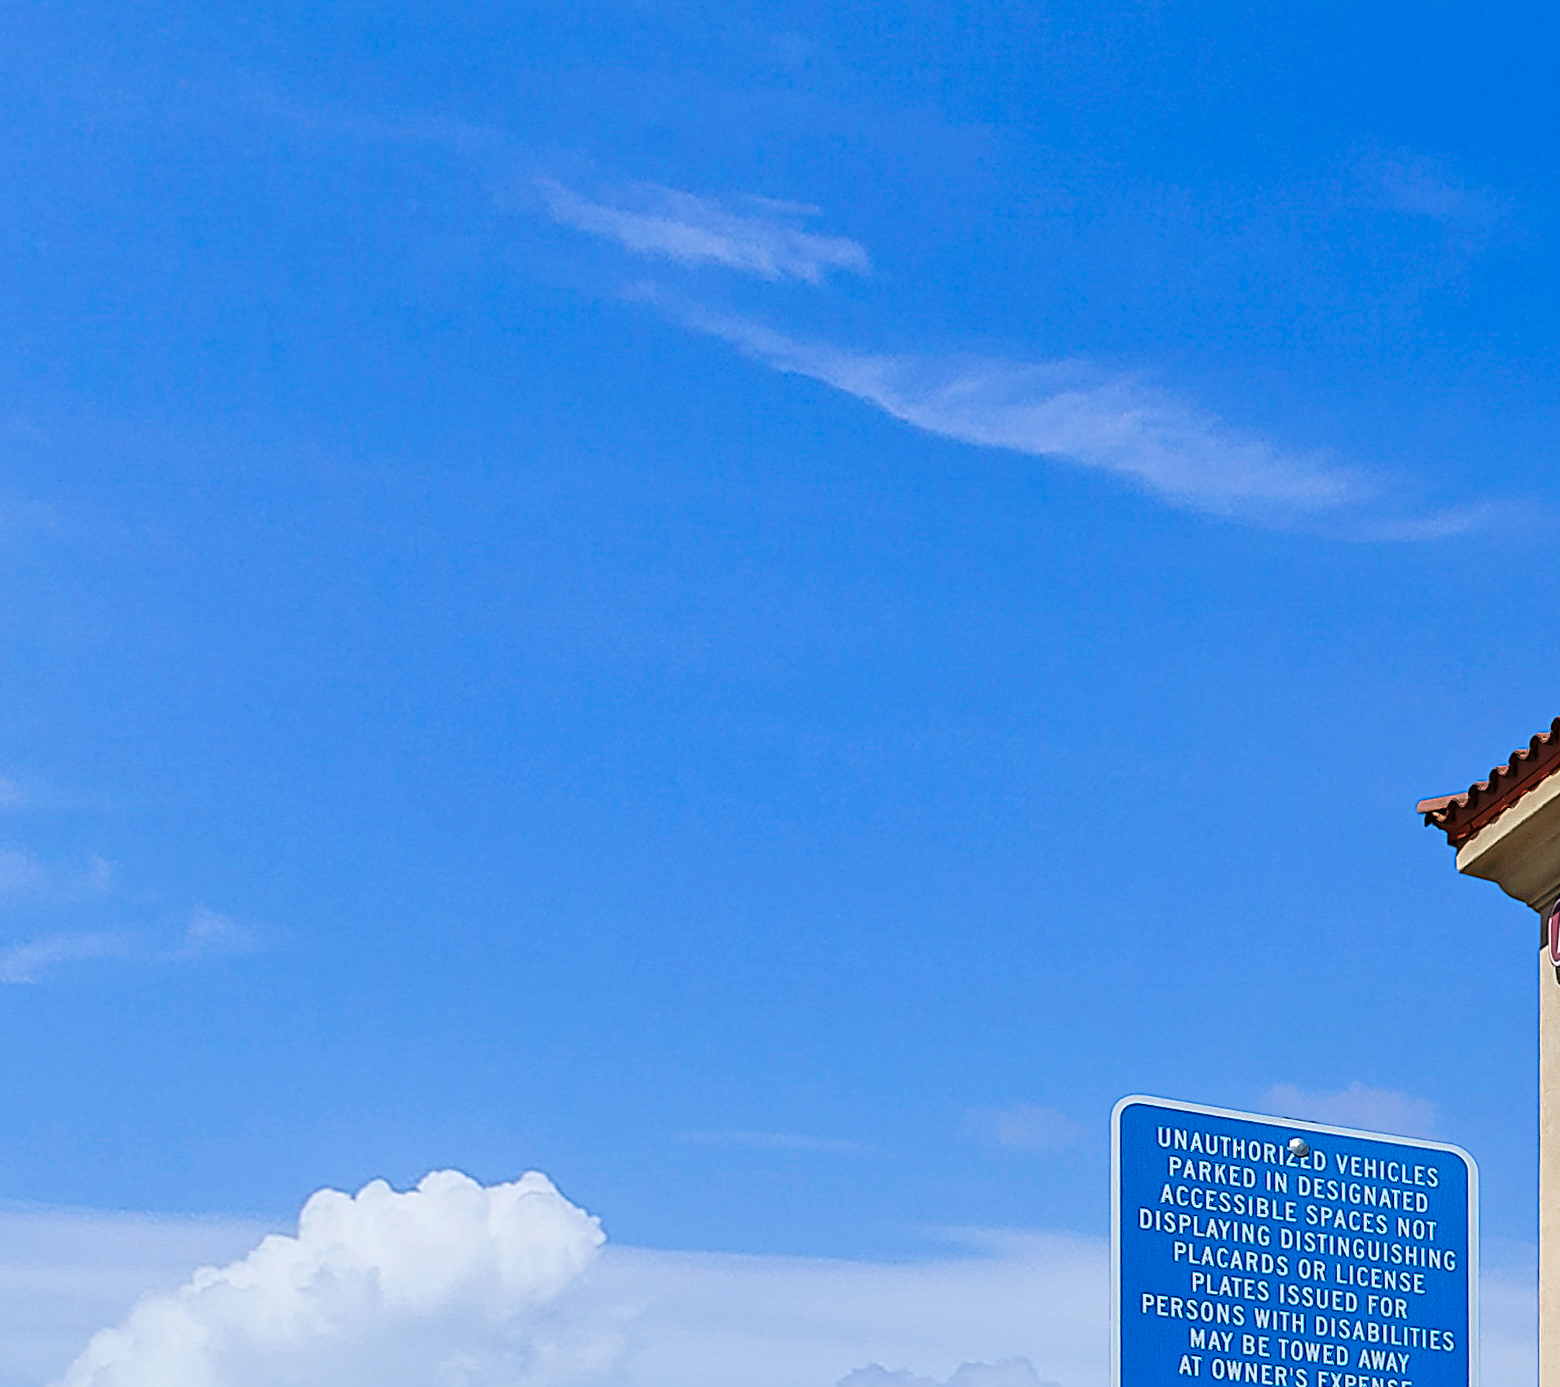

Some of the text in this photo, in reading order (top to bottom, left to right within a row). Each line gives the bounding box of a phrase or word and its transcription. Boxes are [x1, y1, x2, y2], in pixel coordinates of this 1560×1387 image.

[1157, 1125, 1438, 1187] UNAUTHORIZED VEHICLES
[1169, 1156, 1428, 1213] PARKED IN DESIGNATED
[1139, 1207, 1456, 1271] DISPLAYING DISTINGUISHING
[1160, 1184, 1436, 1241] ACCESSIBLE SPACES NOT
[1174, 1242, 1425, 1294] PLACARDS OR LICENSE
[1192, 1272, 1407, 1319] PLATES ISSUED FOR
[1142, 1293, 1455, 1352] PERSONS WITH DISABILITIES
[1179, 1355, 1202, 1376] AT
[1189, 1328, 1409, 1375] MAY BE TOWED AWAY
